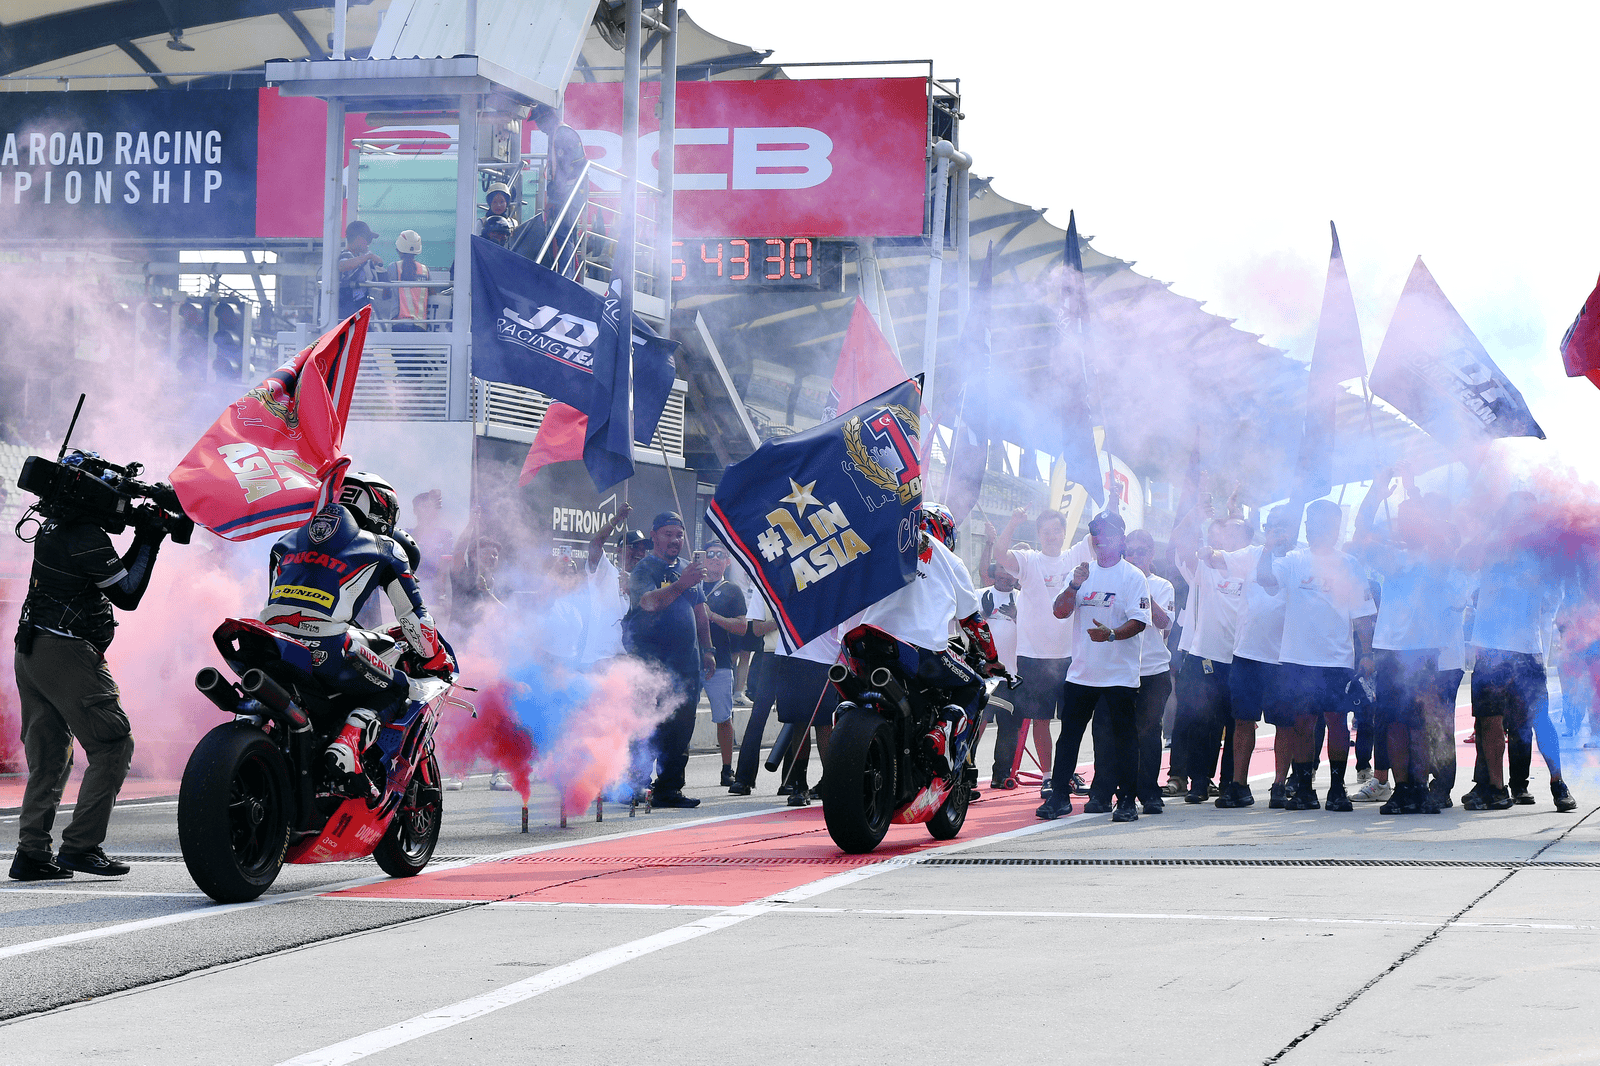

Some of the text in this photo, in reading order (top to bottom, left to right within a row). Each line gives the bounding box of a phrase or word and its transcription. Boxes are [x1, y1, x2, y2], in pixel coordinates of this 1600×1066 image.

[29, 131, 104, 166] ROAD
[115, 130, 222, 165] RACING
[530, 126, 834, 191] RCB
[0, 169, 223, 204] PIONSHIP
[700, 239, 750, 280] 43
[765, 238, 813, 280] 30
[496, 318, 564, 354] RACING
[217, 443, 282, 504] ASIA
[757, 501, 850, 563] #1 IN
[282, 550, 348, 574] DUCATI
[790, 527, 872, 592] ASIA
[282, 586, 331, 602] DUNLOP
[360, 645, 392, 676] DUCATI
